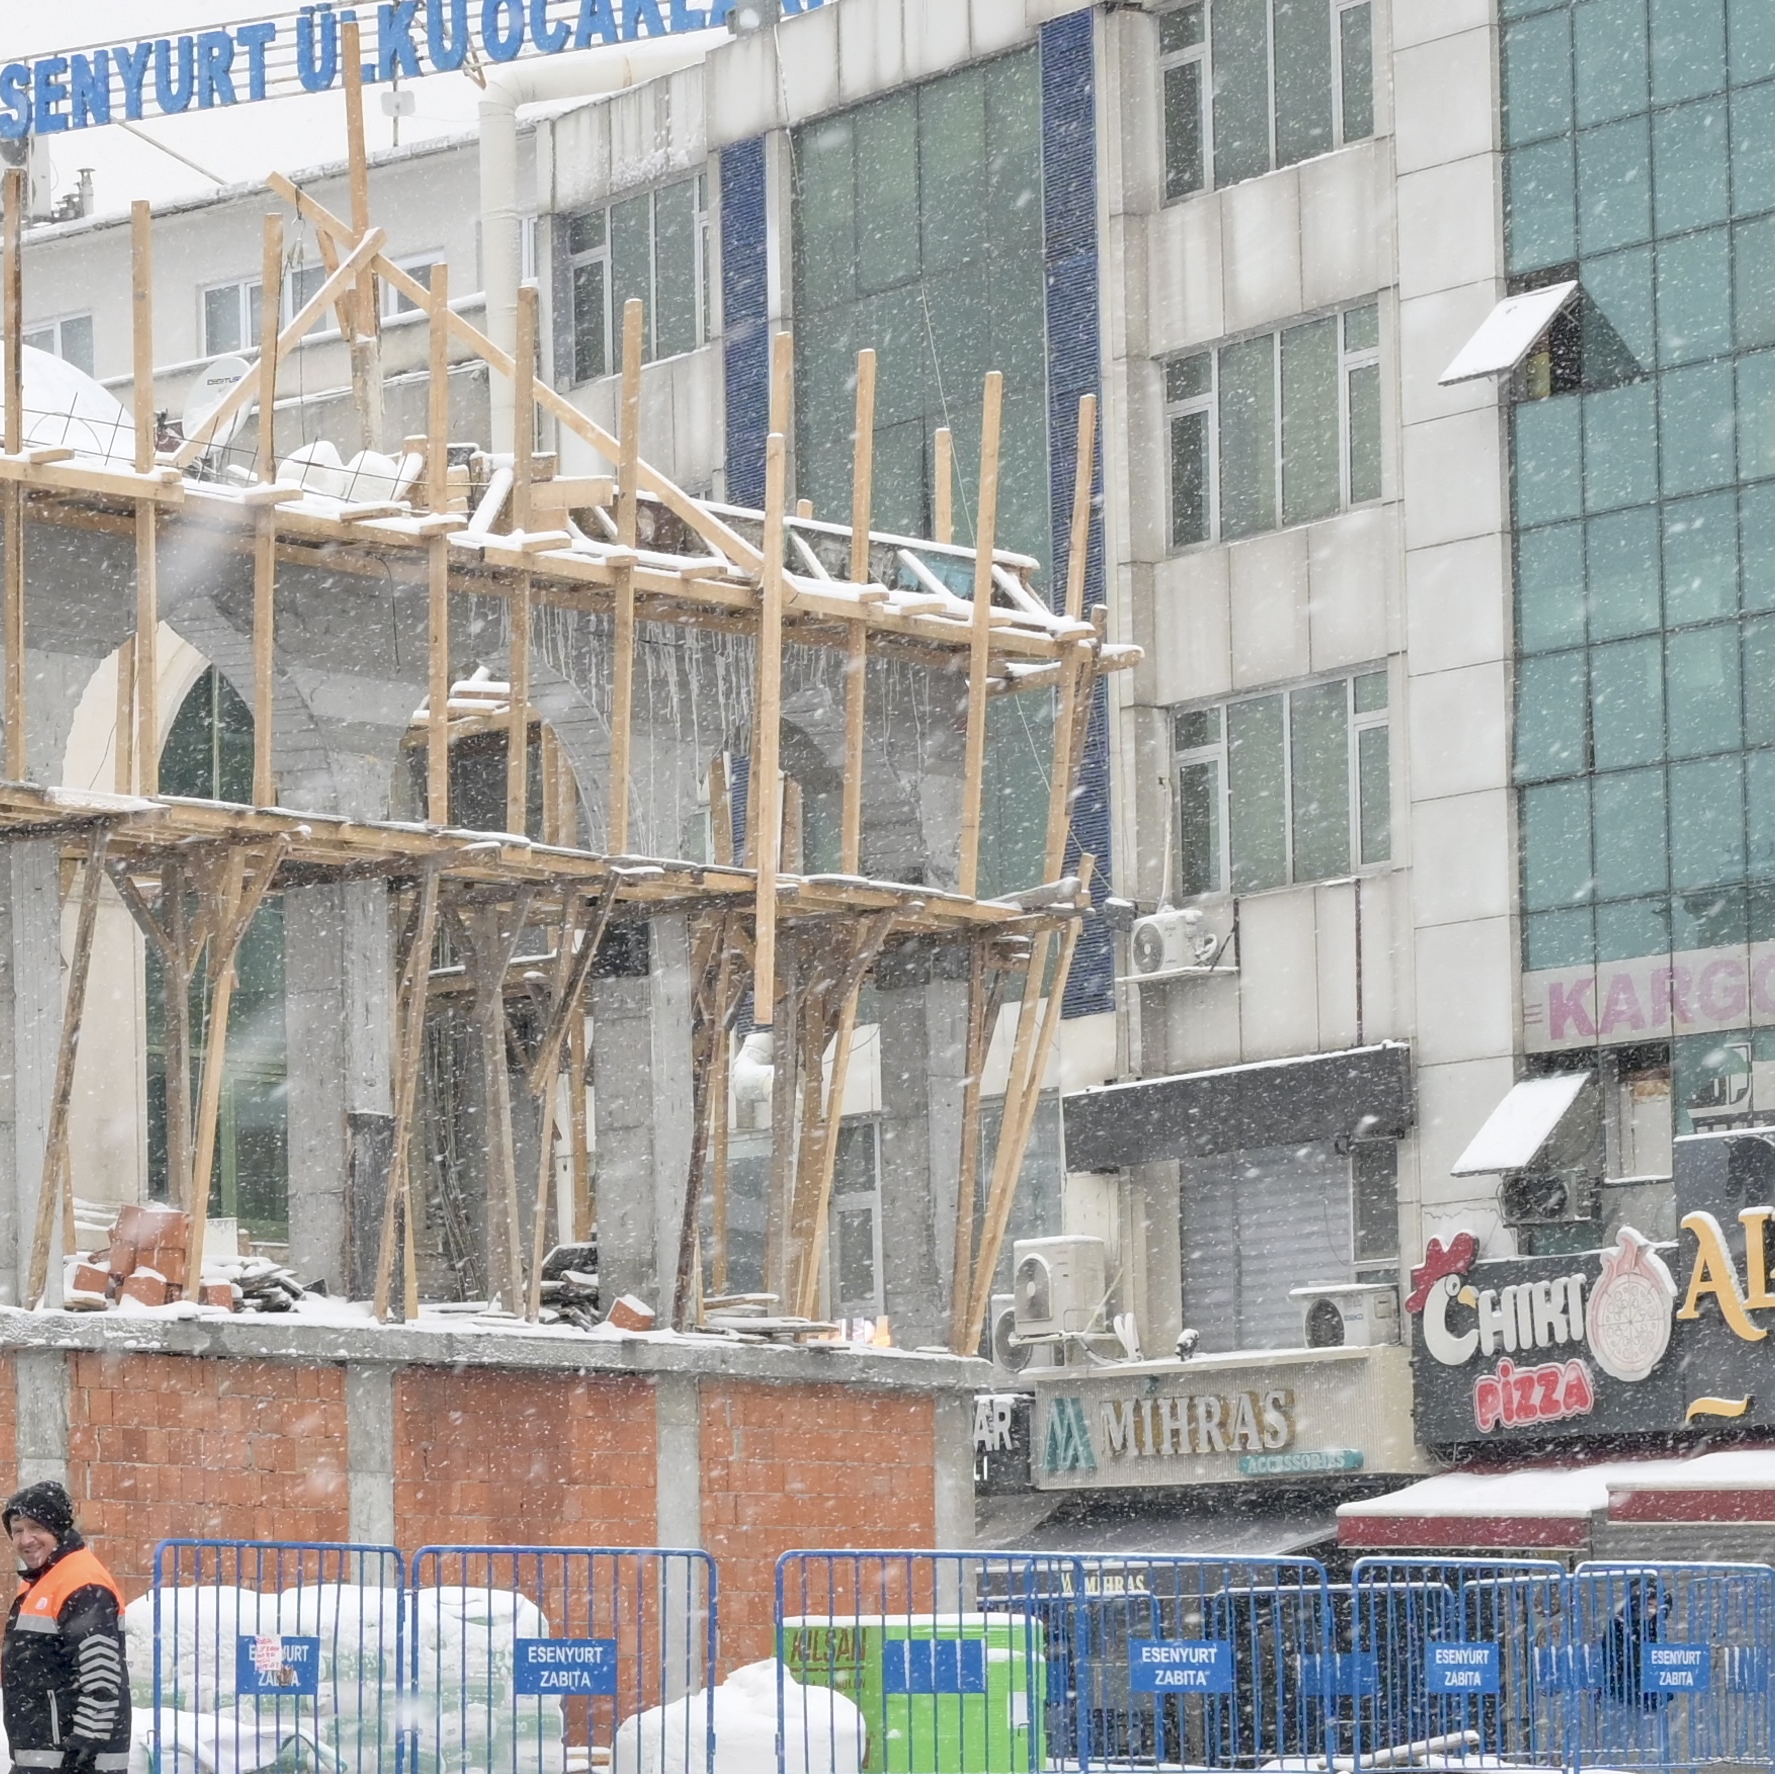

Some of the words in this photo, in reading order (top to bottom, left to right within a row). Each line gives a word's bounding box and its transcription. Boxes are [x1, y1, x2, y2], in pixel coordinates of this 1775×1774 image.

[1676, 1206, 1775, 1342] AL
[248, 1644, 310, 1662] EURT
[528, 1646, 604, 1663] ESENYURT
[1141, 1647, 1219, 1663] ESENYURT
[1435, 1649, 1490, 1665] ESENYURT
[1651, 1650, 1702, 1665] ESENYURT
[258, 1669, 300, 1687] ZAA
